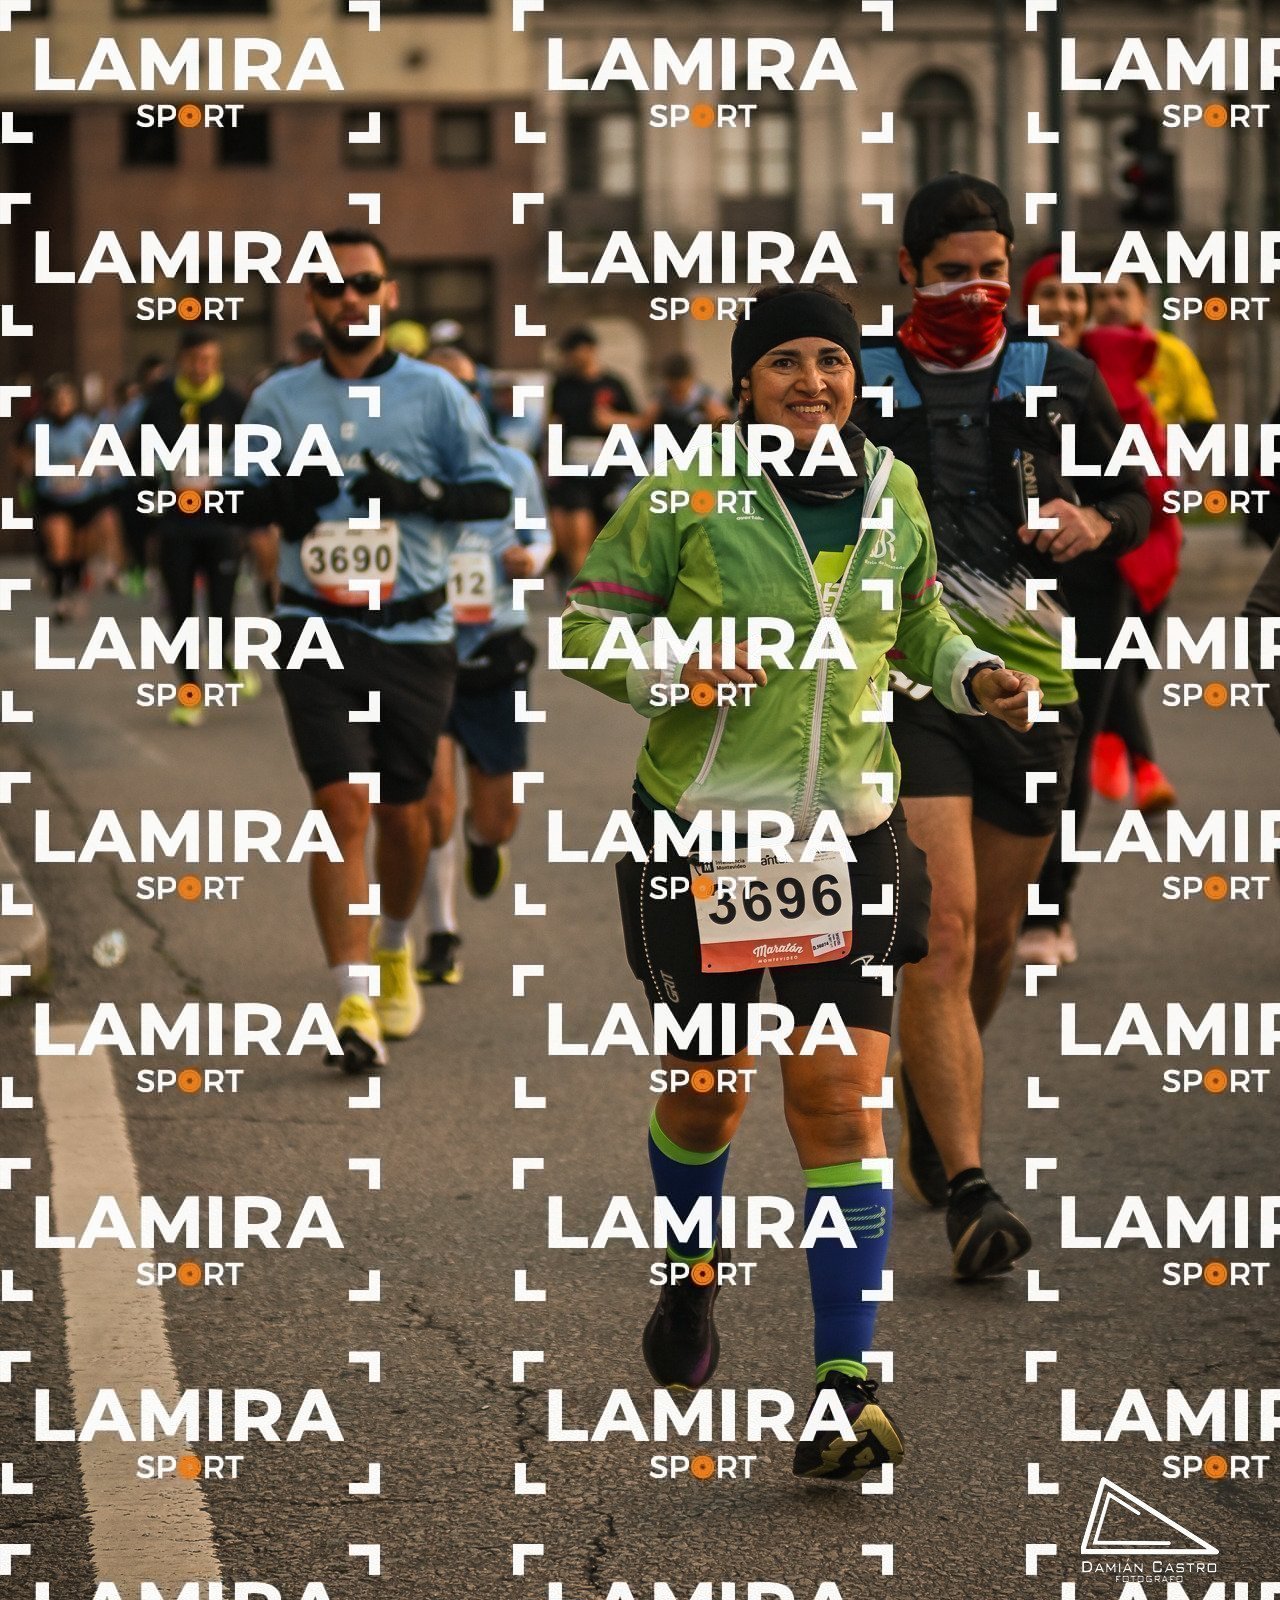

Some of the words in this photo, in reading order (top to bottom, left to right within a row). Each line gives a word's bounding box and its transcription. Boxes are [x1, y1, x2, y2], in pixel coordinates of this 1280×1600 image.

[309, 544, 392, 575] 3690
[708, 874, 842, 925] 3696
[753, 943, 803, 958] Maratón
